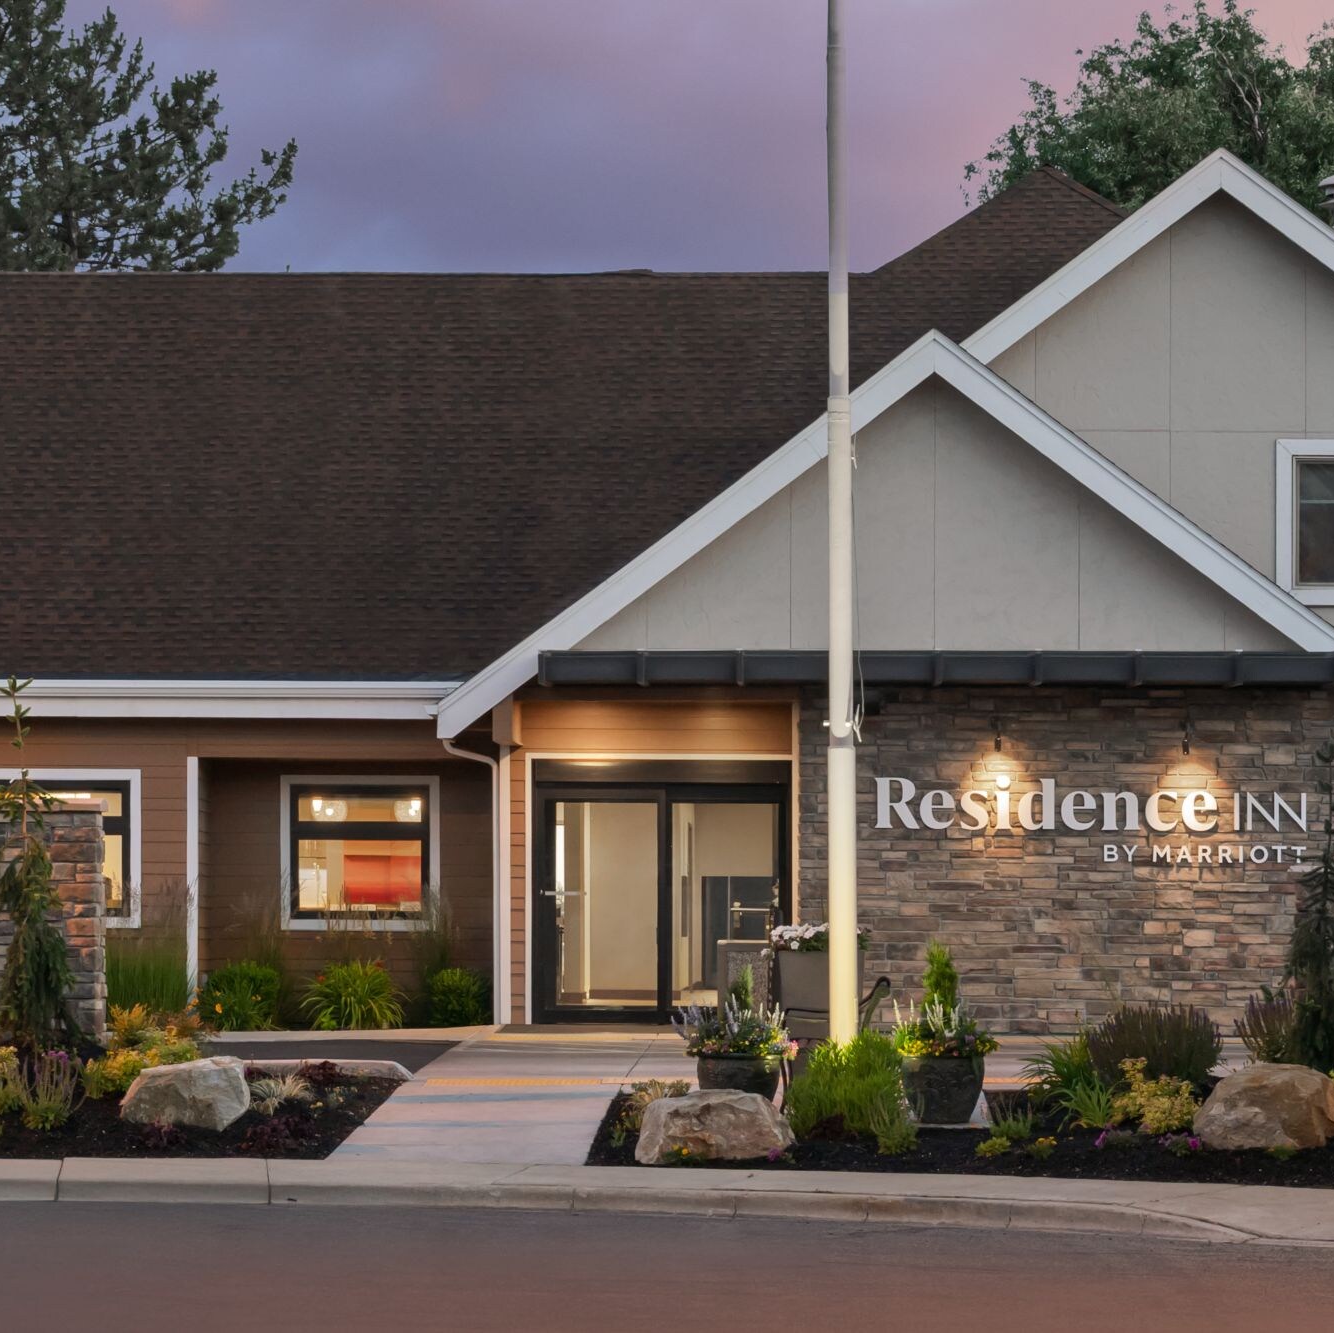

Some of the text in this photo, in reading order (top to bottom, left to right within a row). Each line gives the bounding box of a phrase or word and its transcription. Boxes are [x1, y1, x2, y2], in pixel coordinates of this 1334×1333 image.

[874, 775, 1308, 832] Residence INN
[1103, 845, 1307, 864] BY MARRIOTT
